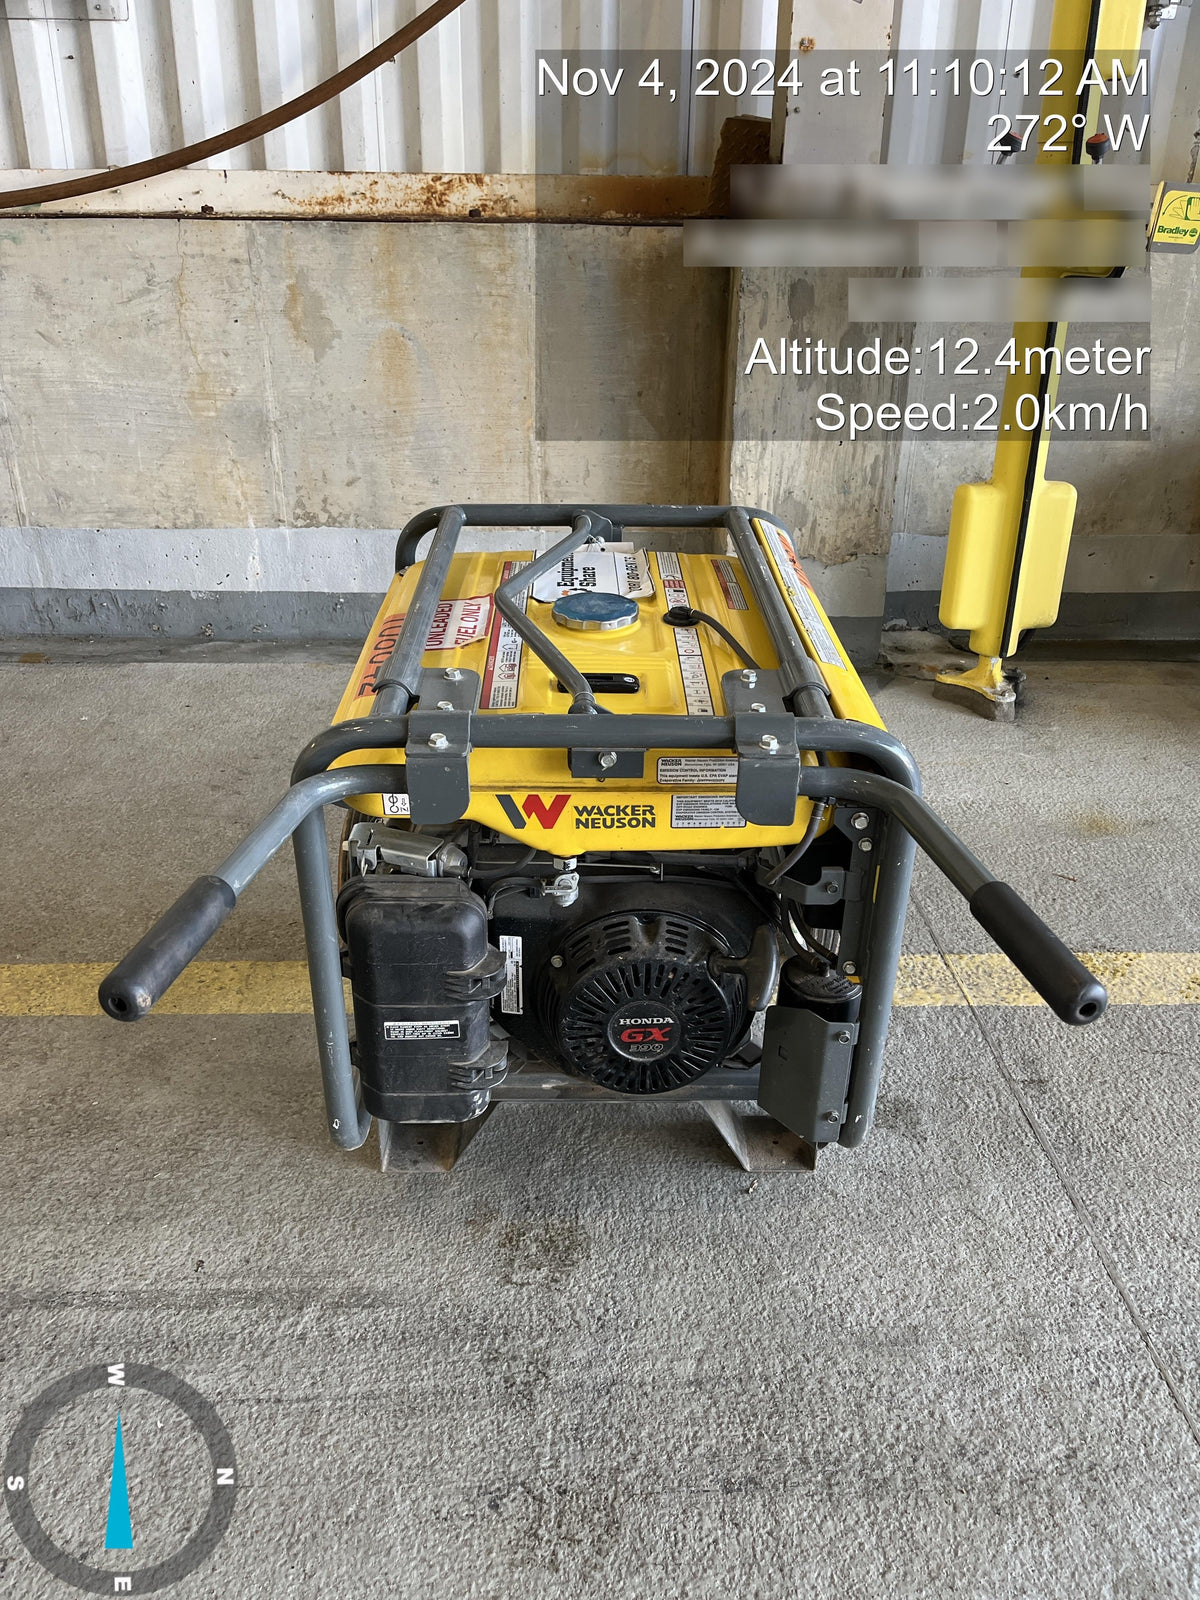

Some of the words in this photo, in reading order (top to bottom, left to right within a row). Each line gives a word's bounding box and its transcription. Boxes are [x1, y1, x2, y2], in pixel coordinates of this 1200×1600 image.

[1157, 225, 1189, 237] Bradley
[557, 553, 579, 587] Equipme
[579, 566, 597, 587] Share
[460, 601, 481, 622] ONLY
[425, 602, 453, 647] UNLEADED
[454, 625, 478, 645] FUEL
[573, 804, 656, 817] WACKER
[575, 817, 656, 829] NEUSON
[618, 1017, 675, 1025] HONDA
[620, 1027, 672, 1043] GX
